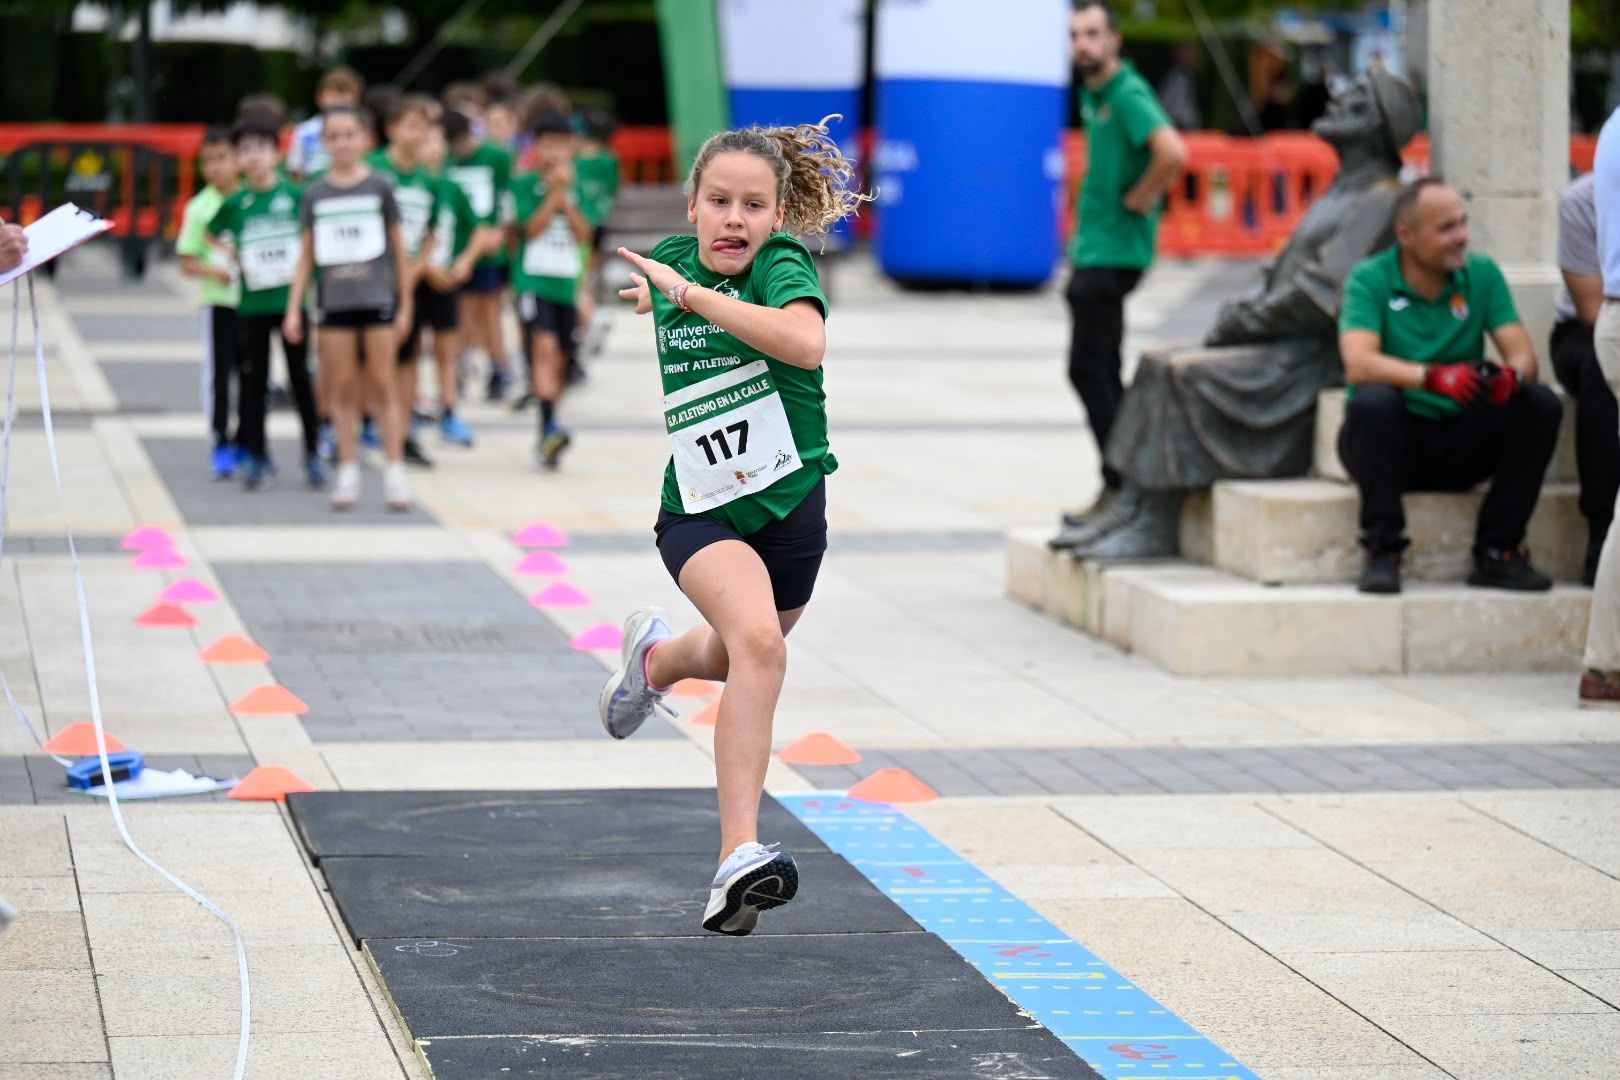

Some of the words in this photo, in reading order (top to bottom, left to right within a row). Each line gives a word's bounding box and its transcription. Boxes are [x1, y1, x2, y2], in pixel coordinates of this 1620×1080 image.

[669, 339, 679, 347] de
[678, 336, 706, 350] león
[692, 355, 741, 371] ATLETISMO
[678, 400, 717, 424] ATLETISMO
[715, 395, 731, 408] EN
[728, 391, 742, 404] LA
[740, 379, 770, 398] CALLE
[695, 420, 749, 466] 117
